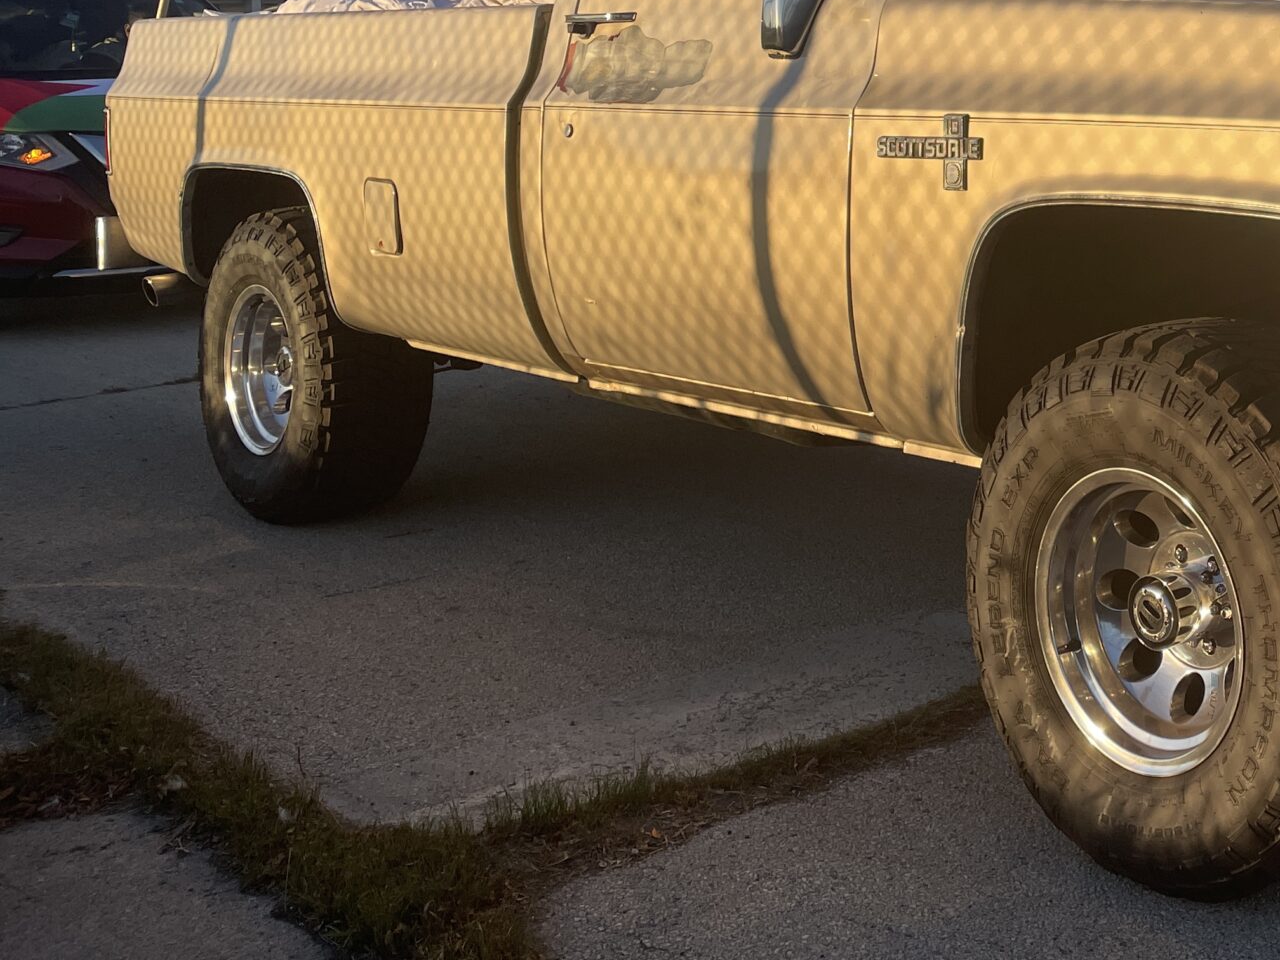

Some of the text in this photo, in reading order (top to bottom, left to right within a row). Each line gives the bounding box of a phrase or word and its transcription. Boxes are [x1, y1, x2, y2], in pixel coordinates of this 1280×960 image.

[877, 137, 982, 159] SCOTTSDALE
[1001, 446, 1039, 511] EXP
[1225, 574, 1280, 809] THOMPSON
